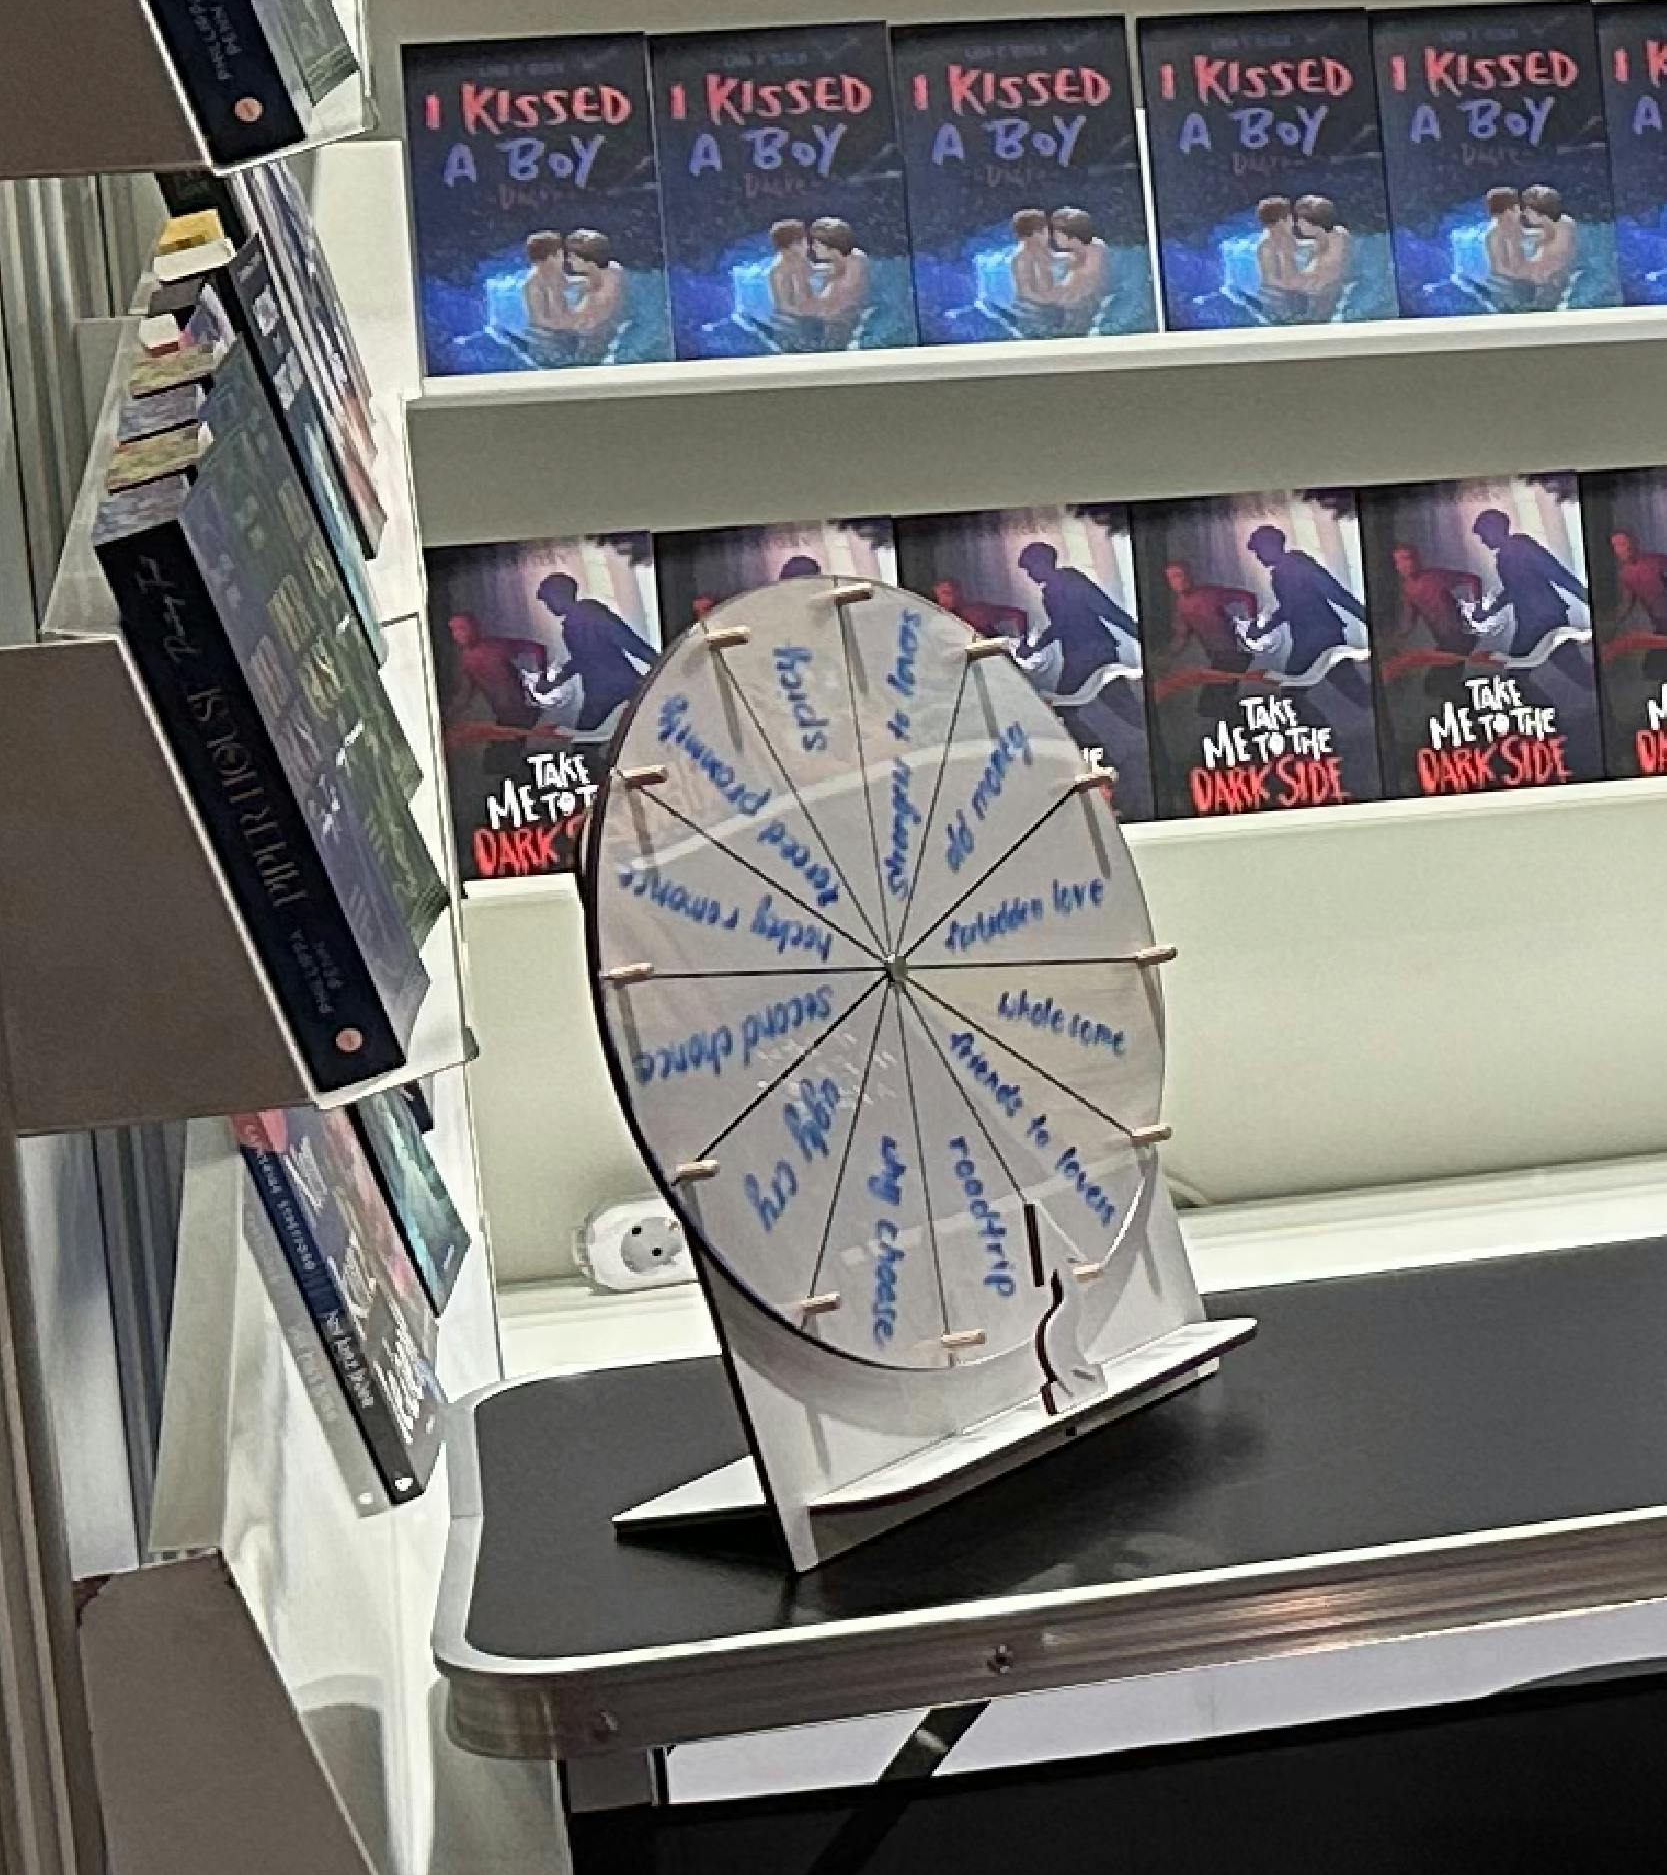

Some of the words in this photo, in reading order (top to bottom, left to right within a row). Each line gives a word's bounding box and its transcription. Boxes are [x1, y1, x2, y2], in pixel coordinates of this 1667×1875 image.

[669, 84, 687, 120] I
[705, 73, 872, 119] KISSED
[688, 134, 722, 178] A
[1239, 693, 1298, 733] TAKE
[1201, 719, 1248, 769] ME
[1253, 731, 1285, 758] TO
[1290, 727, 1332, 756] THE
[1189, 755, 1276, 814] DARK
[1277, 755, 1349, 807] SIDE
[1051, 878, 1107, 919] love
